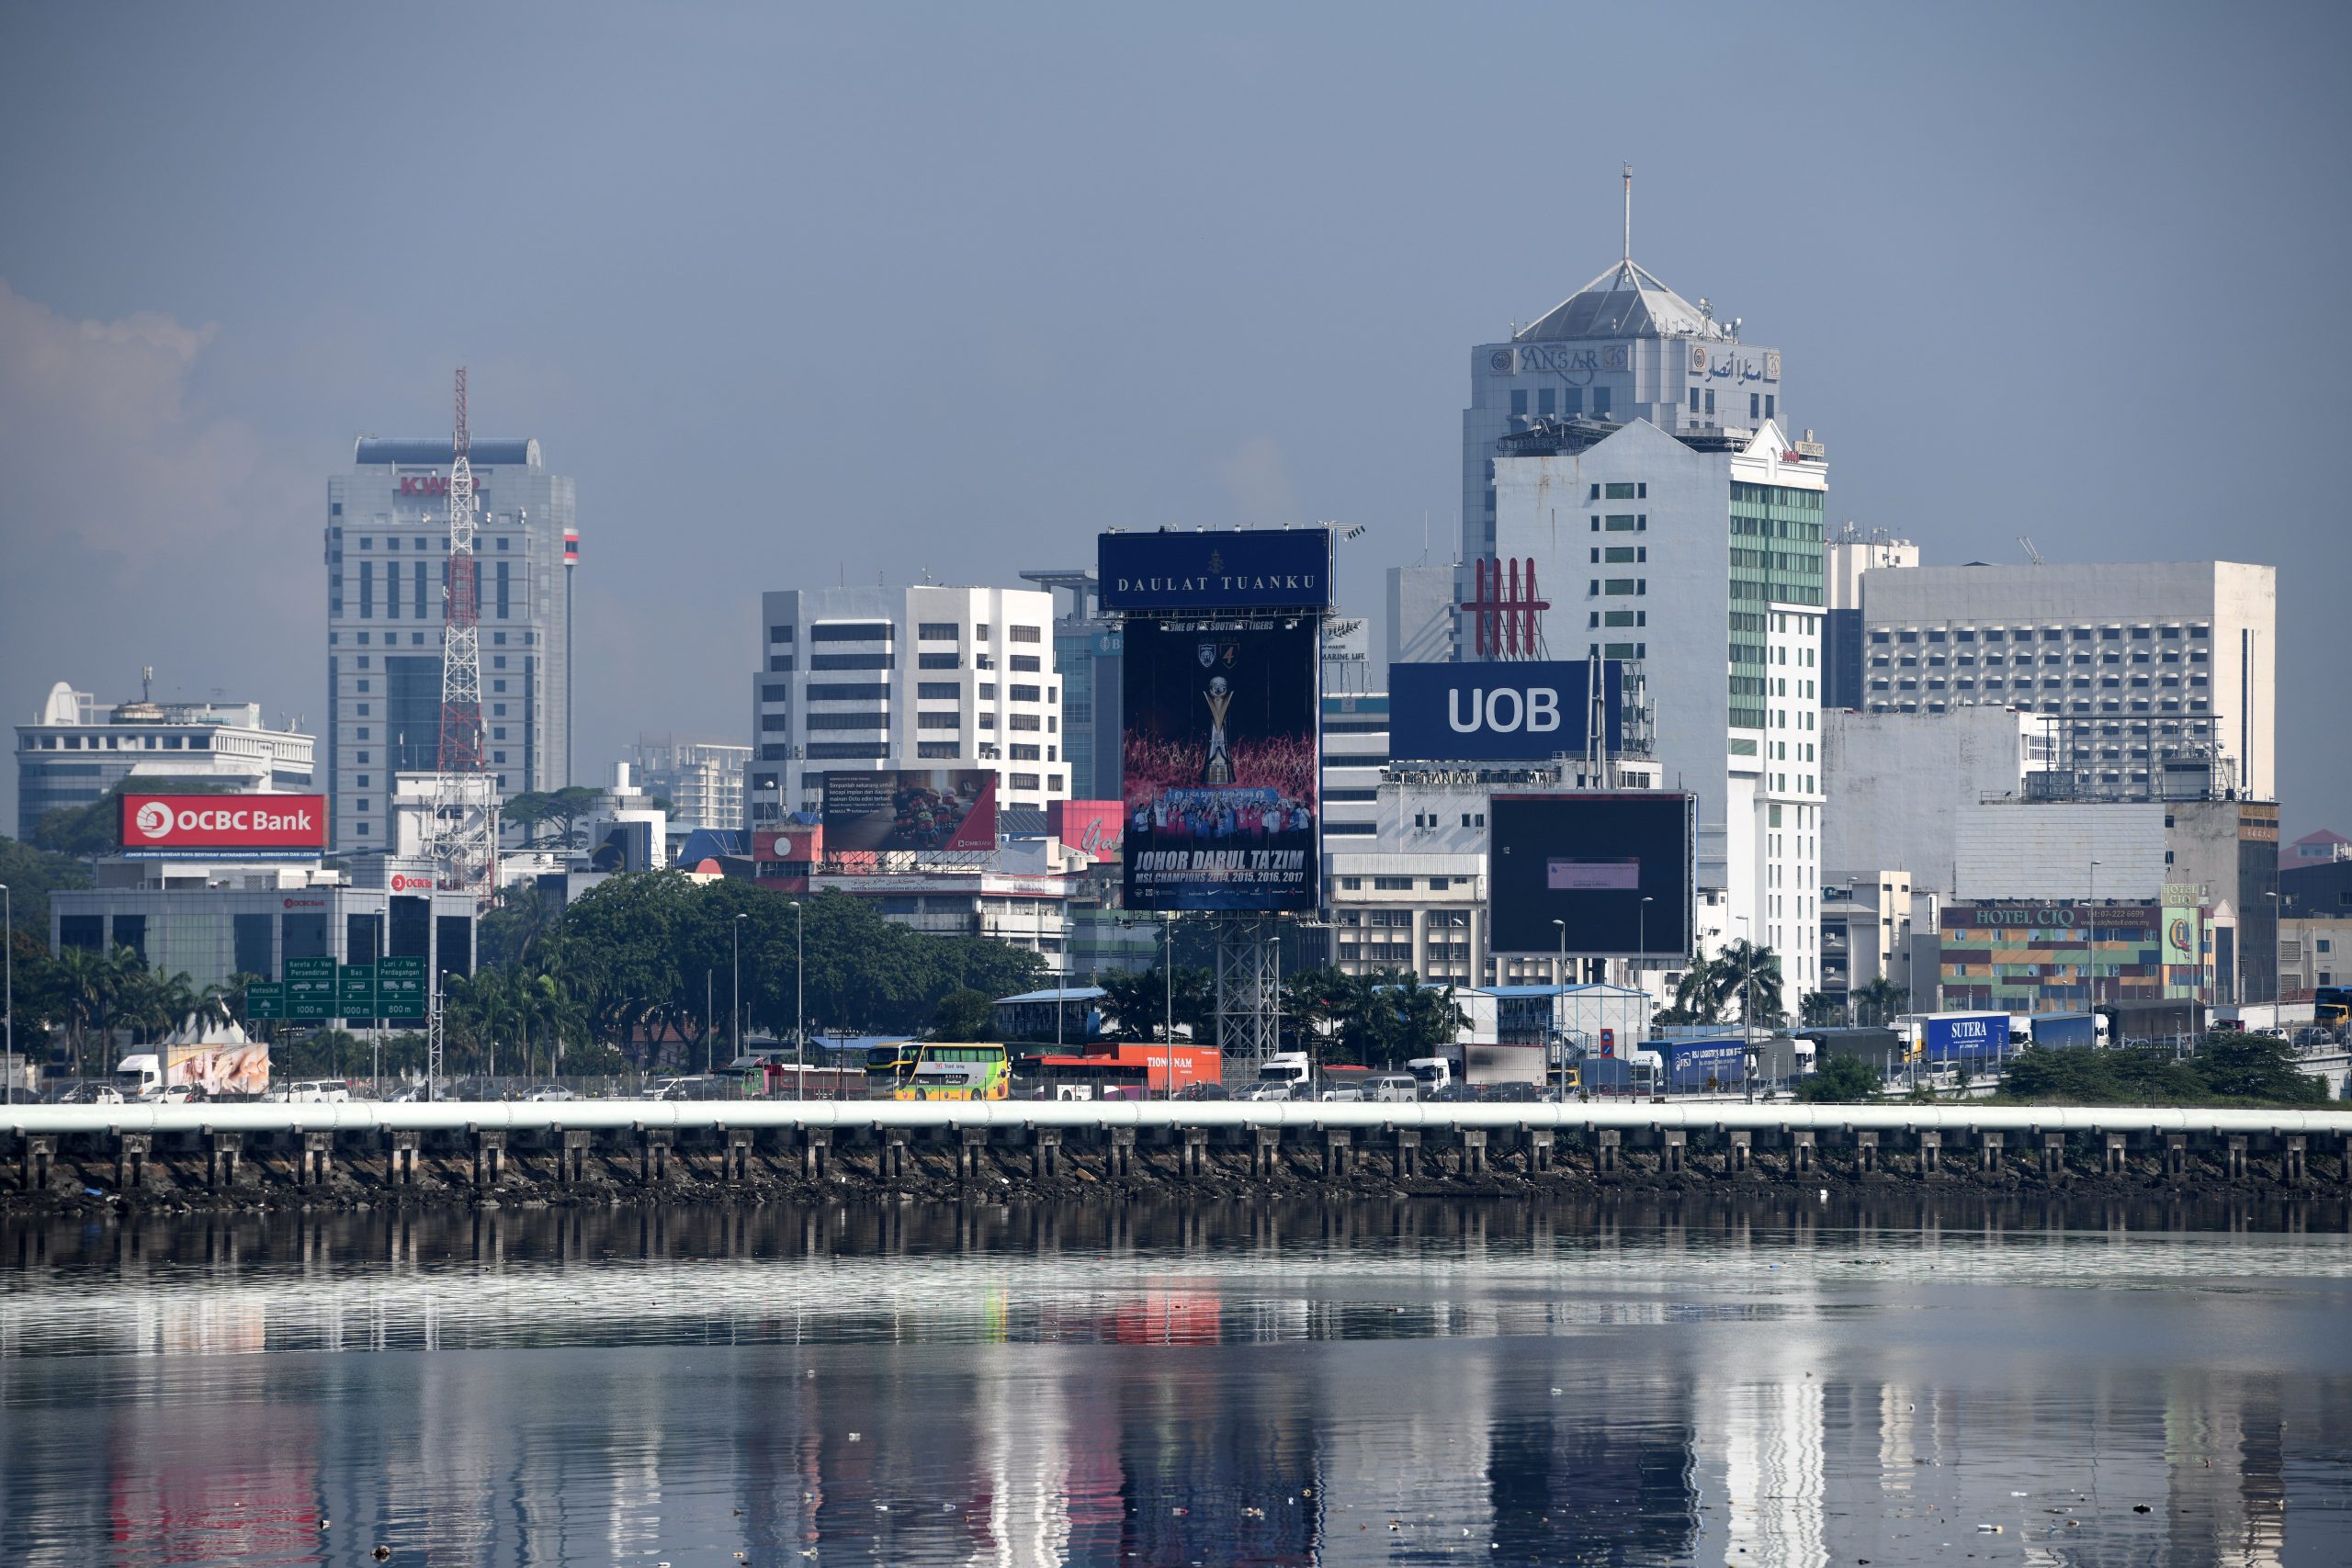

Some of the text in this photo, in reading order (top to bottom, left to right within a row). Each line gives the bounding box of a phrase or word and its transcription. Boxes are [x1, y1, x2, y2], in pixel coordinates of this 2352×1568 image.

[1117, 575, 1315, 591] DAULAT TUANKU
[1169, 622, 1185, 632] OME
[1186, 622, 1195, 631] OF
[1249, 621, 1274, 630] TIGERS
[1223, 646, 1234, 663] 4
[1449, 688, 1560, 733] UOB
[177, 810, 312, 830] OCBC Bank
[1135, 850, 1304, 870] JOHOR DARUL TA'ZIM
[1136, 872, 1303, 883] MSL CHAMPIONS 2014, 2015, 2016, 2017
[2169, 895, 2191, 904] CIQ
[1977, 911, 2033, 925] HOTEL
[2037, 910, 2075, 928] CIQ
[1951, 1021, 1987, 1038] SUTERA
[1174, 1058, 1192, 1068] NAM
